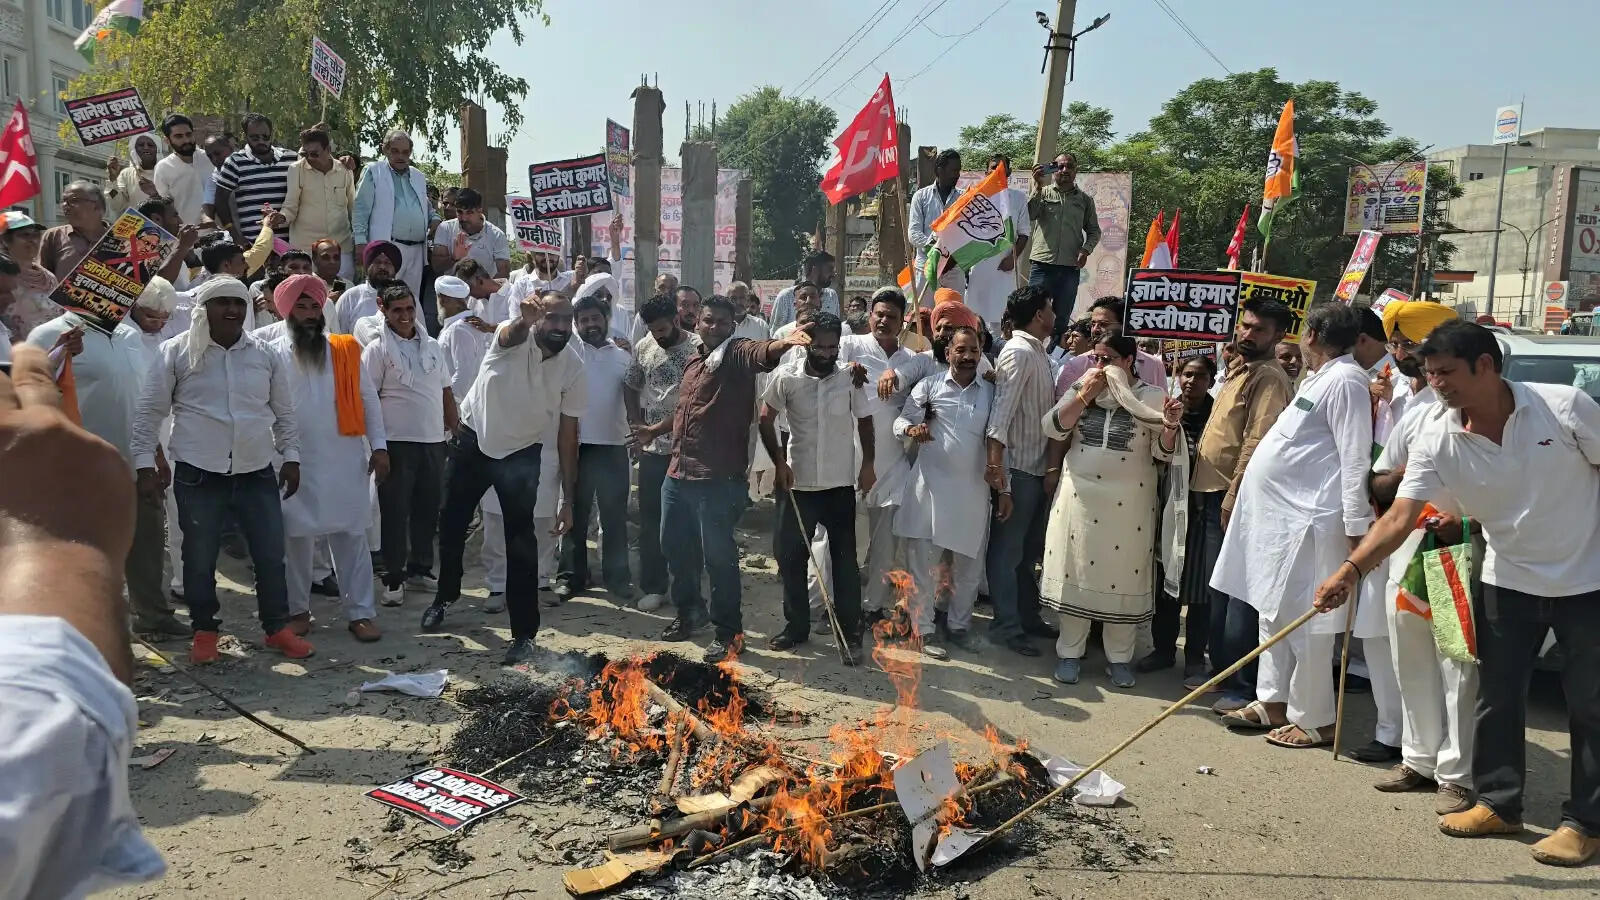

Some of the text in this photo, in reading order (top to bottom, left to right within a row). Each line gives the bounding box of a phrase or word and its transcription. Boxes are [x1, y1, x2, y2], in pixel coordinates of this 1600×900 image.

[70, 95, 142, 123] ज्ञानेश कुमार
[79, 111, 149, 141] इस्तीफा दो
[532, 164, 606, 192] ज्ञानेश कुमार
[512, 202, 533, 220] वो
[535, 190, 592, 214] इस्तीफा
[591, 184, 608, 206] दो
[516, 225, 544, 244] गद्दी
[1550, 229, 1558, 265] TOWER
[1131, 276, 1187, 302] ज्ञानेश
[1188, 283, 1238, 308] कुमार
[1129, 305, 1207, 331] इस्तीफा
[1208, 307, 1232, 334] दो
